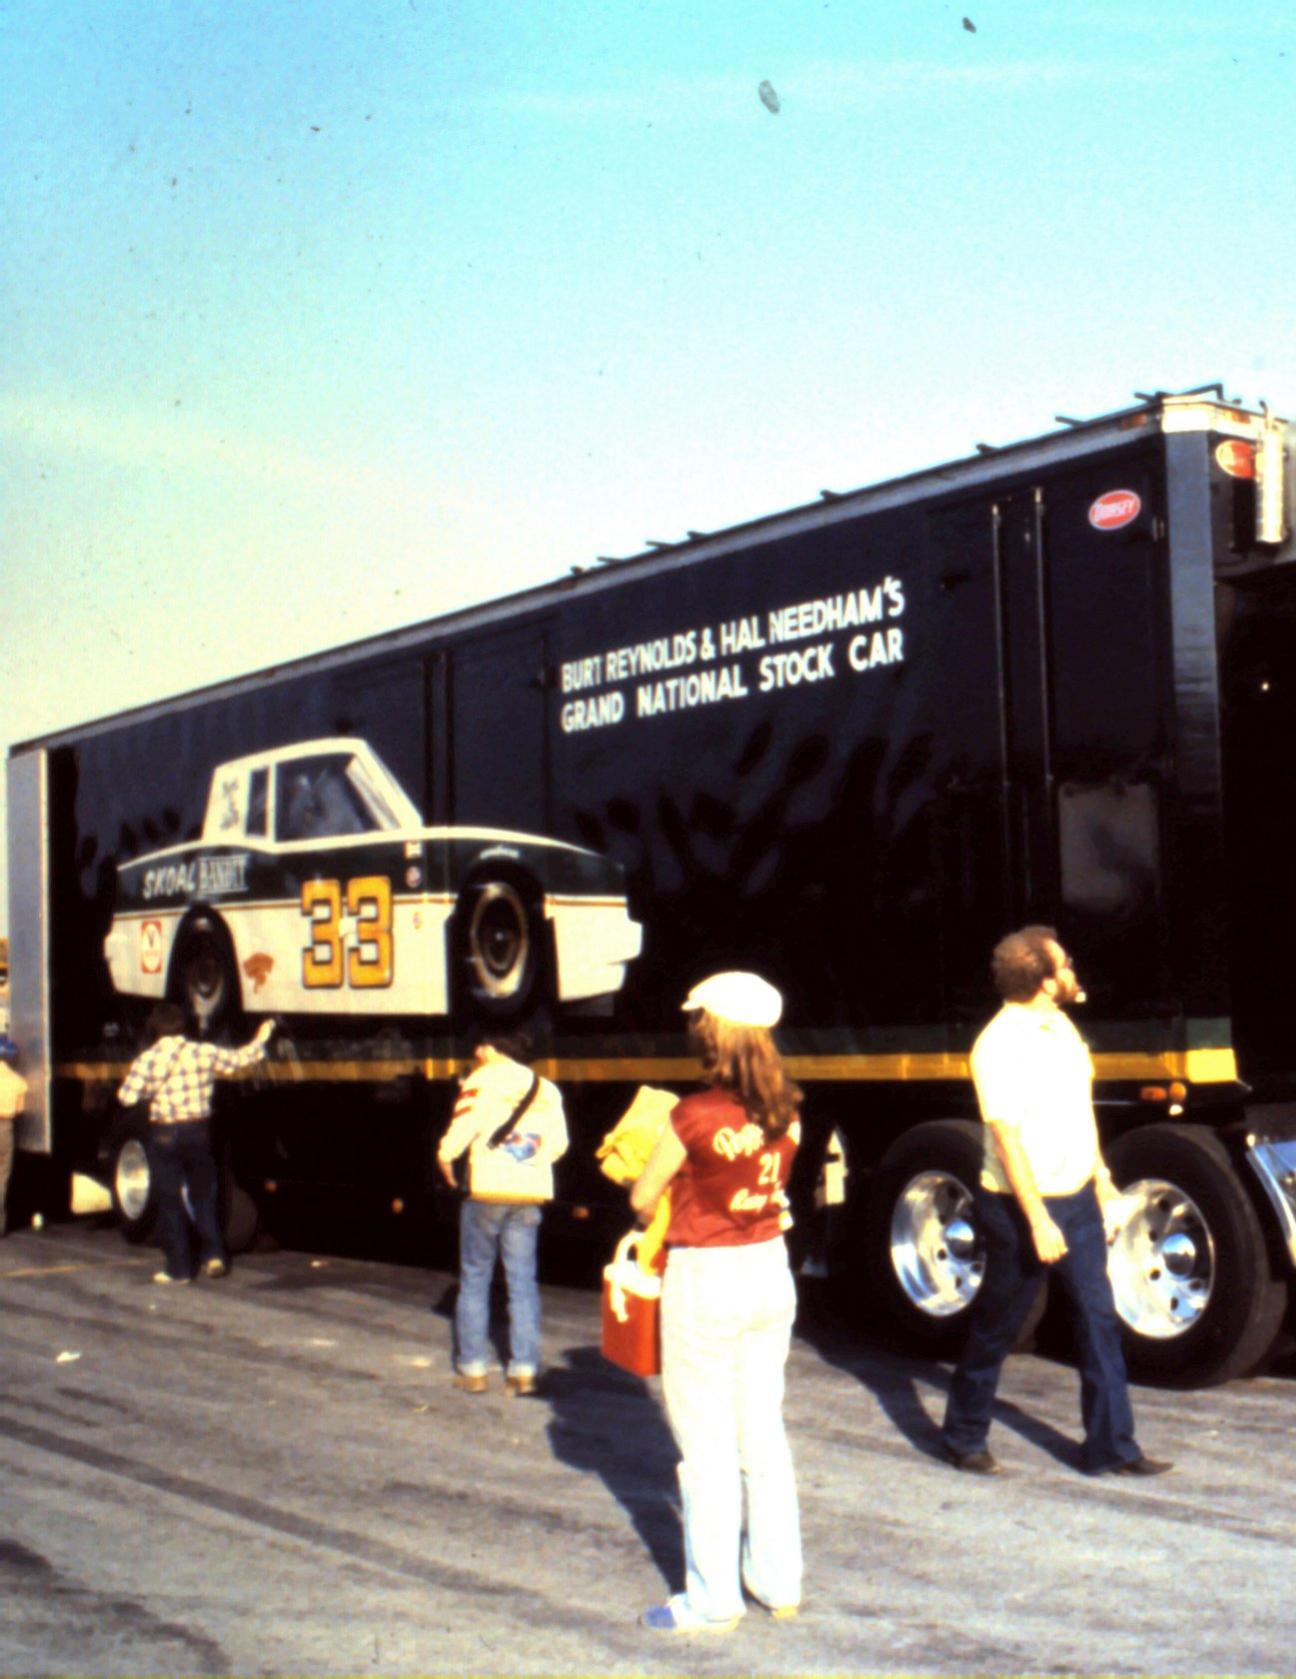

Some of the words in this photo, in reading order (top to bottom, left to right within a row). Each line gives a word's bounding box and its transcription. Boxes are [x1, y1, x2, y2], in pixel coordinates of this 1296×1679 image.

[561, 691, 625, 733] GRAND
[637, 664, 748, 717] NATIONAL
[759, 643, 836, 692] STOCK
[848, 628, 904, 672] CAR
[562, 656, 603, 693] BURT
[606, 630, 697, 682] REYNOLDS
[700, 626, 716, 661] &
[720, 615, 766, 655] HAL
[769, 575, 906, 644] NEEDHAM'S
[143, 863, 195, 899] SKOAL
[302, 876, 393, 989] 33
[758, 1152, 781, 1185] 21
